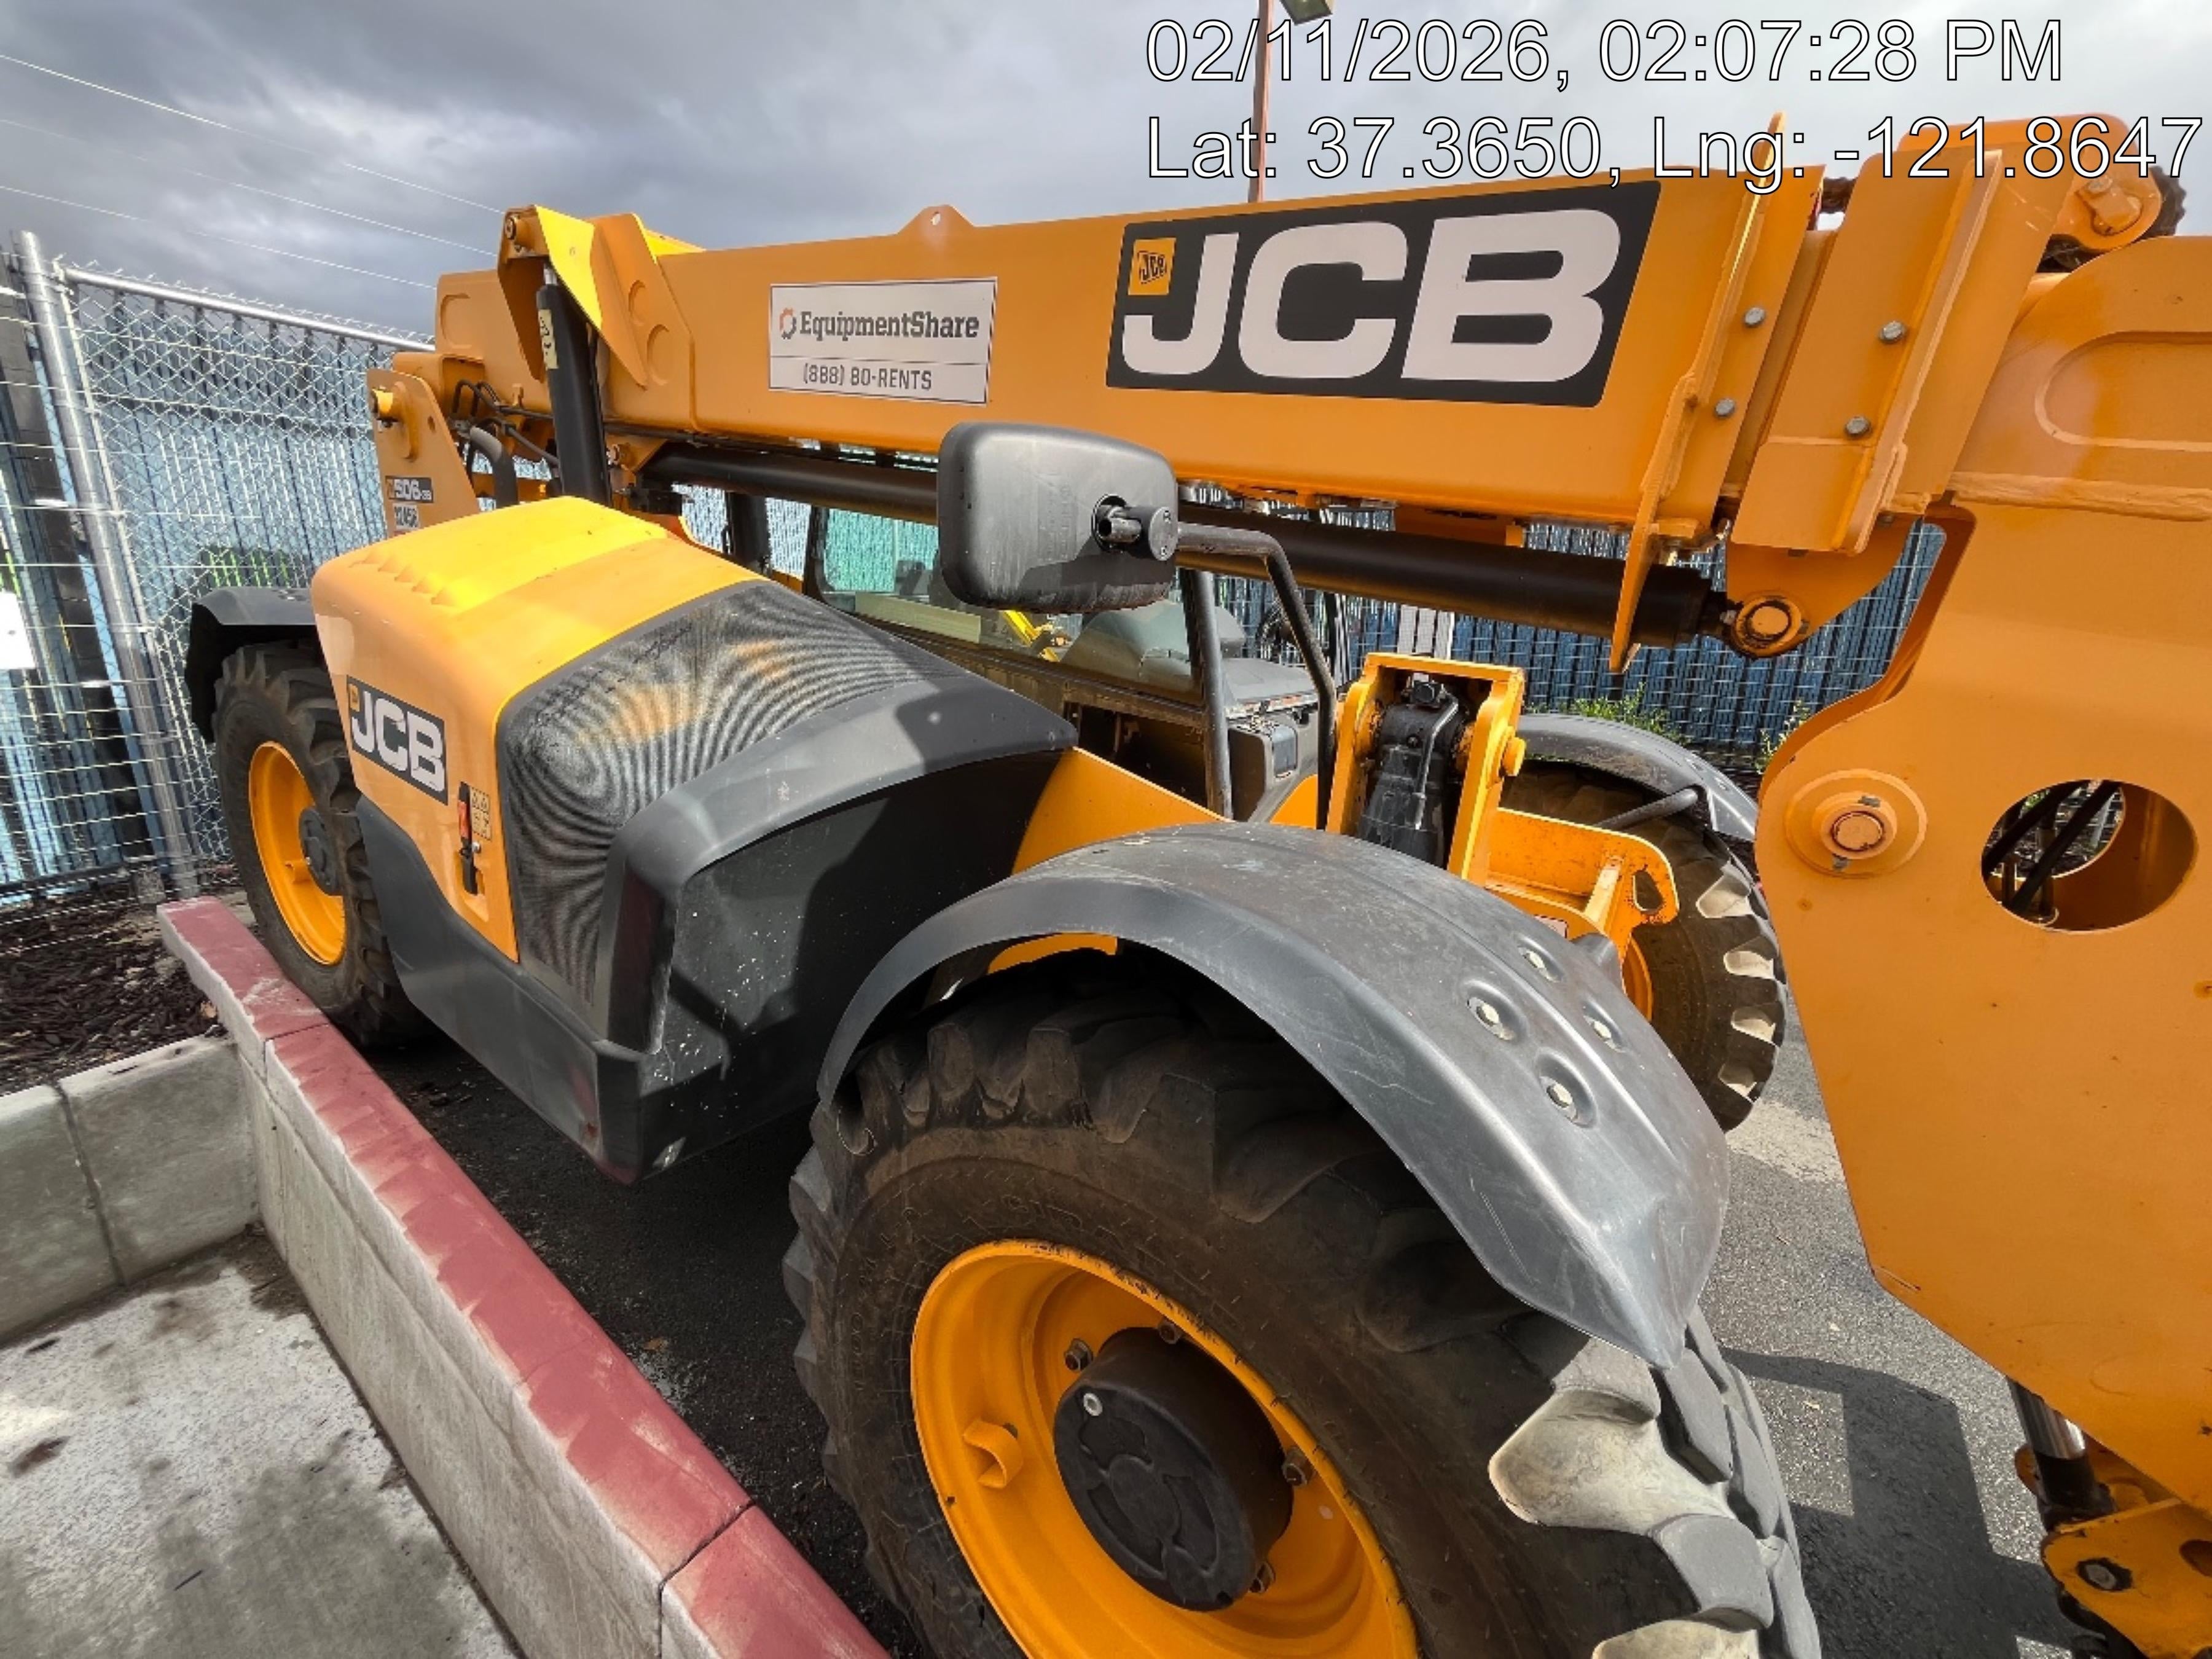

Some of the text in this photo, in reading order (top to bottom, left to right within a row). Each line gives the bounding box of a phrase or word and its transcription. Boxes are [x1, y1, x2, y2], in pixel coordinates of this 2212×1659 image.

[1138, 251, 1166, 283] JCB
[1121, 208, 1621, 383] JCB
[799, 310, 979, 341] EquipmentShare
[803, 363, 932, 390] (888) 80-RENTS
[351, 690, 445, 792] JCB
